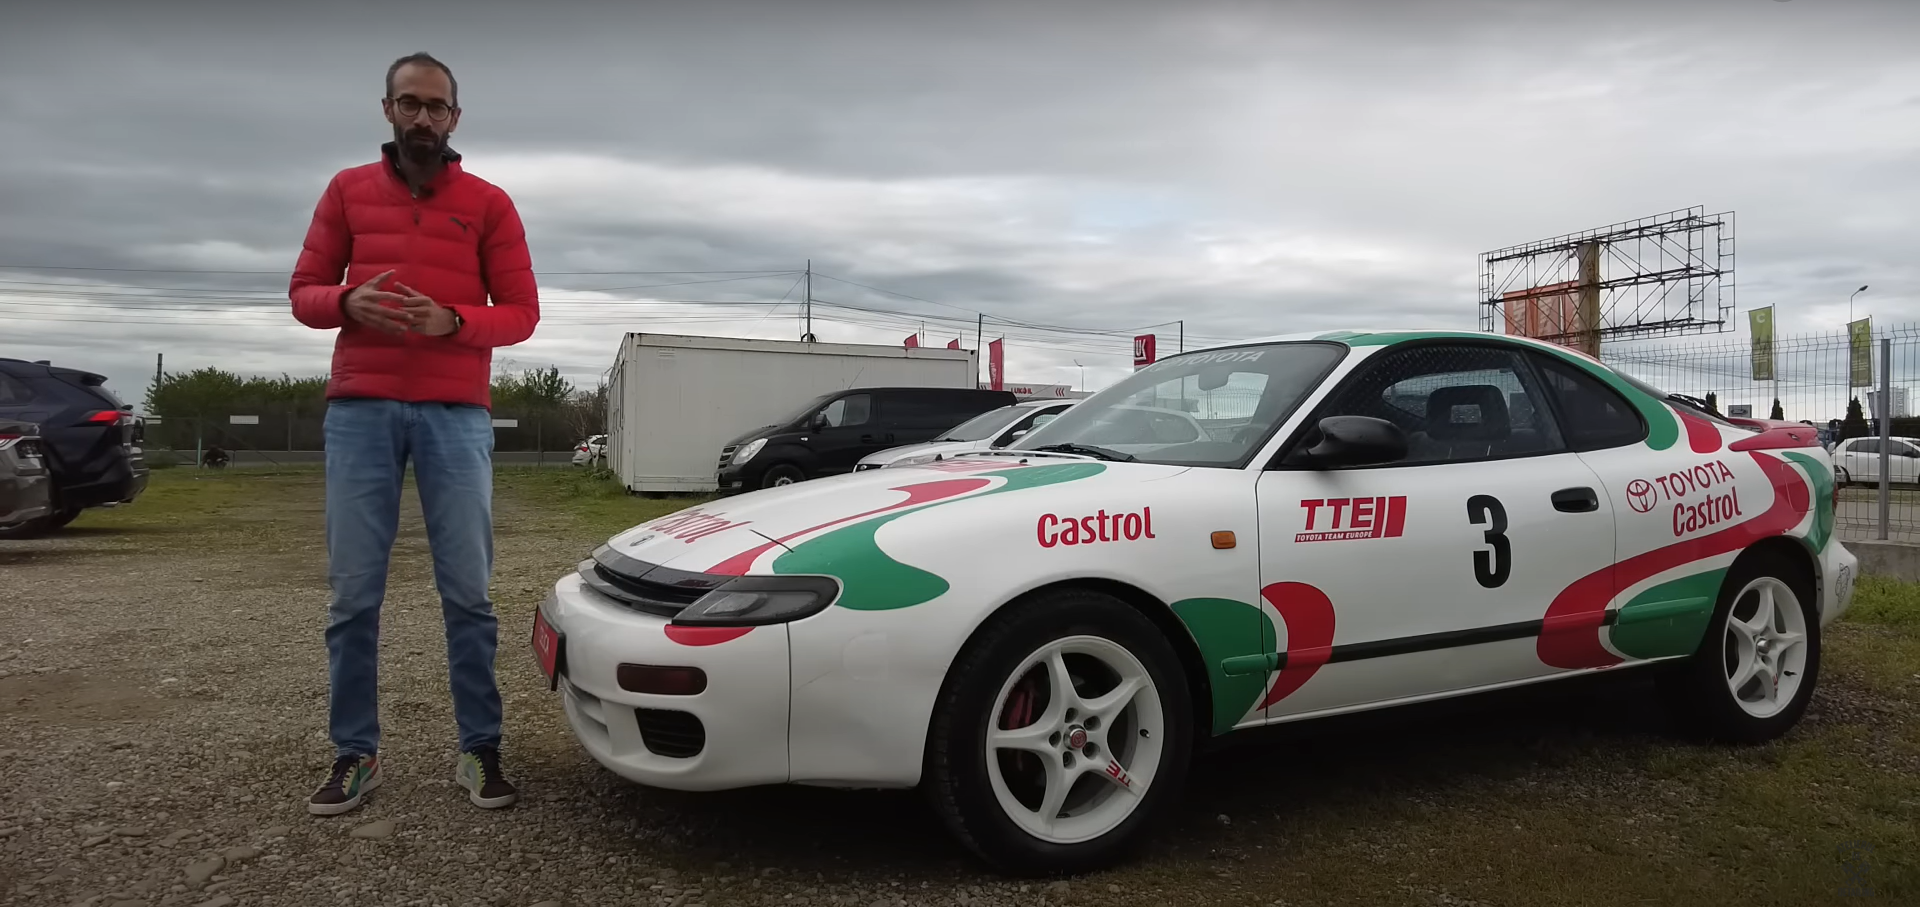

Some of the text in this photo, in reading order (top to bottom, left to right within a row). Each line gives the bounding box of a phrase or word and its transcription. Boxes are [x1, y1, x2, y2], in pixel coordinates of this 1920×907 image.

[1178, 351, 1266, 366] TOYOTA
[1655, 460, 1735, 500] TOYOTA
[1037, 506, 1156, 548] Castrol
[1300, 497, 1374, 531] TTE
[1673, 486, 1742, 537] Castrol
[1296, 531, 1372, 542] TOYOTA TEAM EUROPE
[1467, 494, 1511, 588] 3
[1105, 760, 1131, 787] TTE
